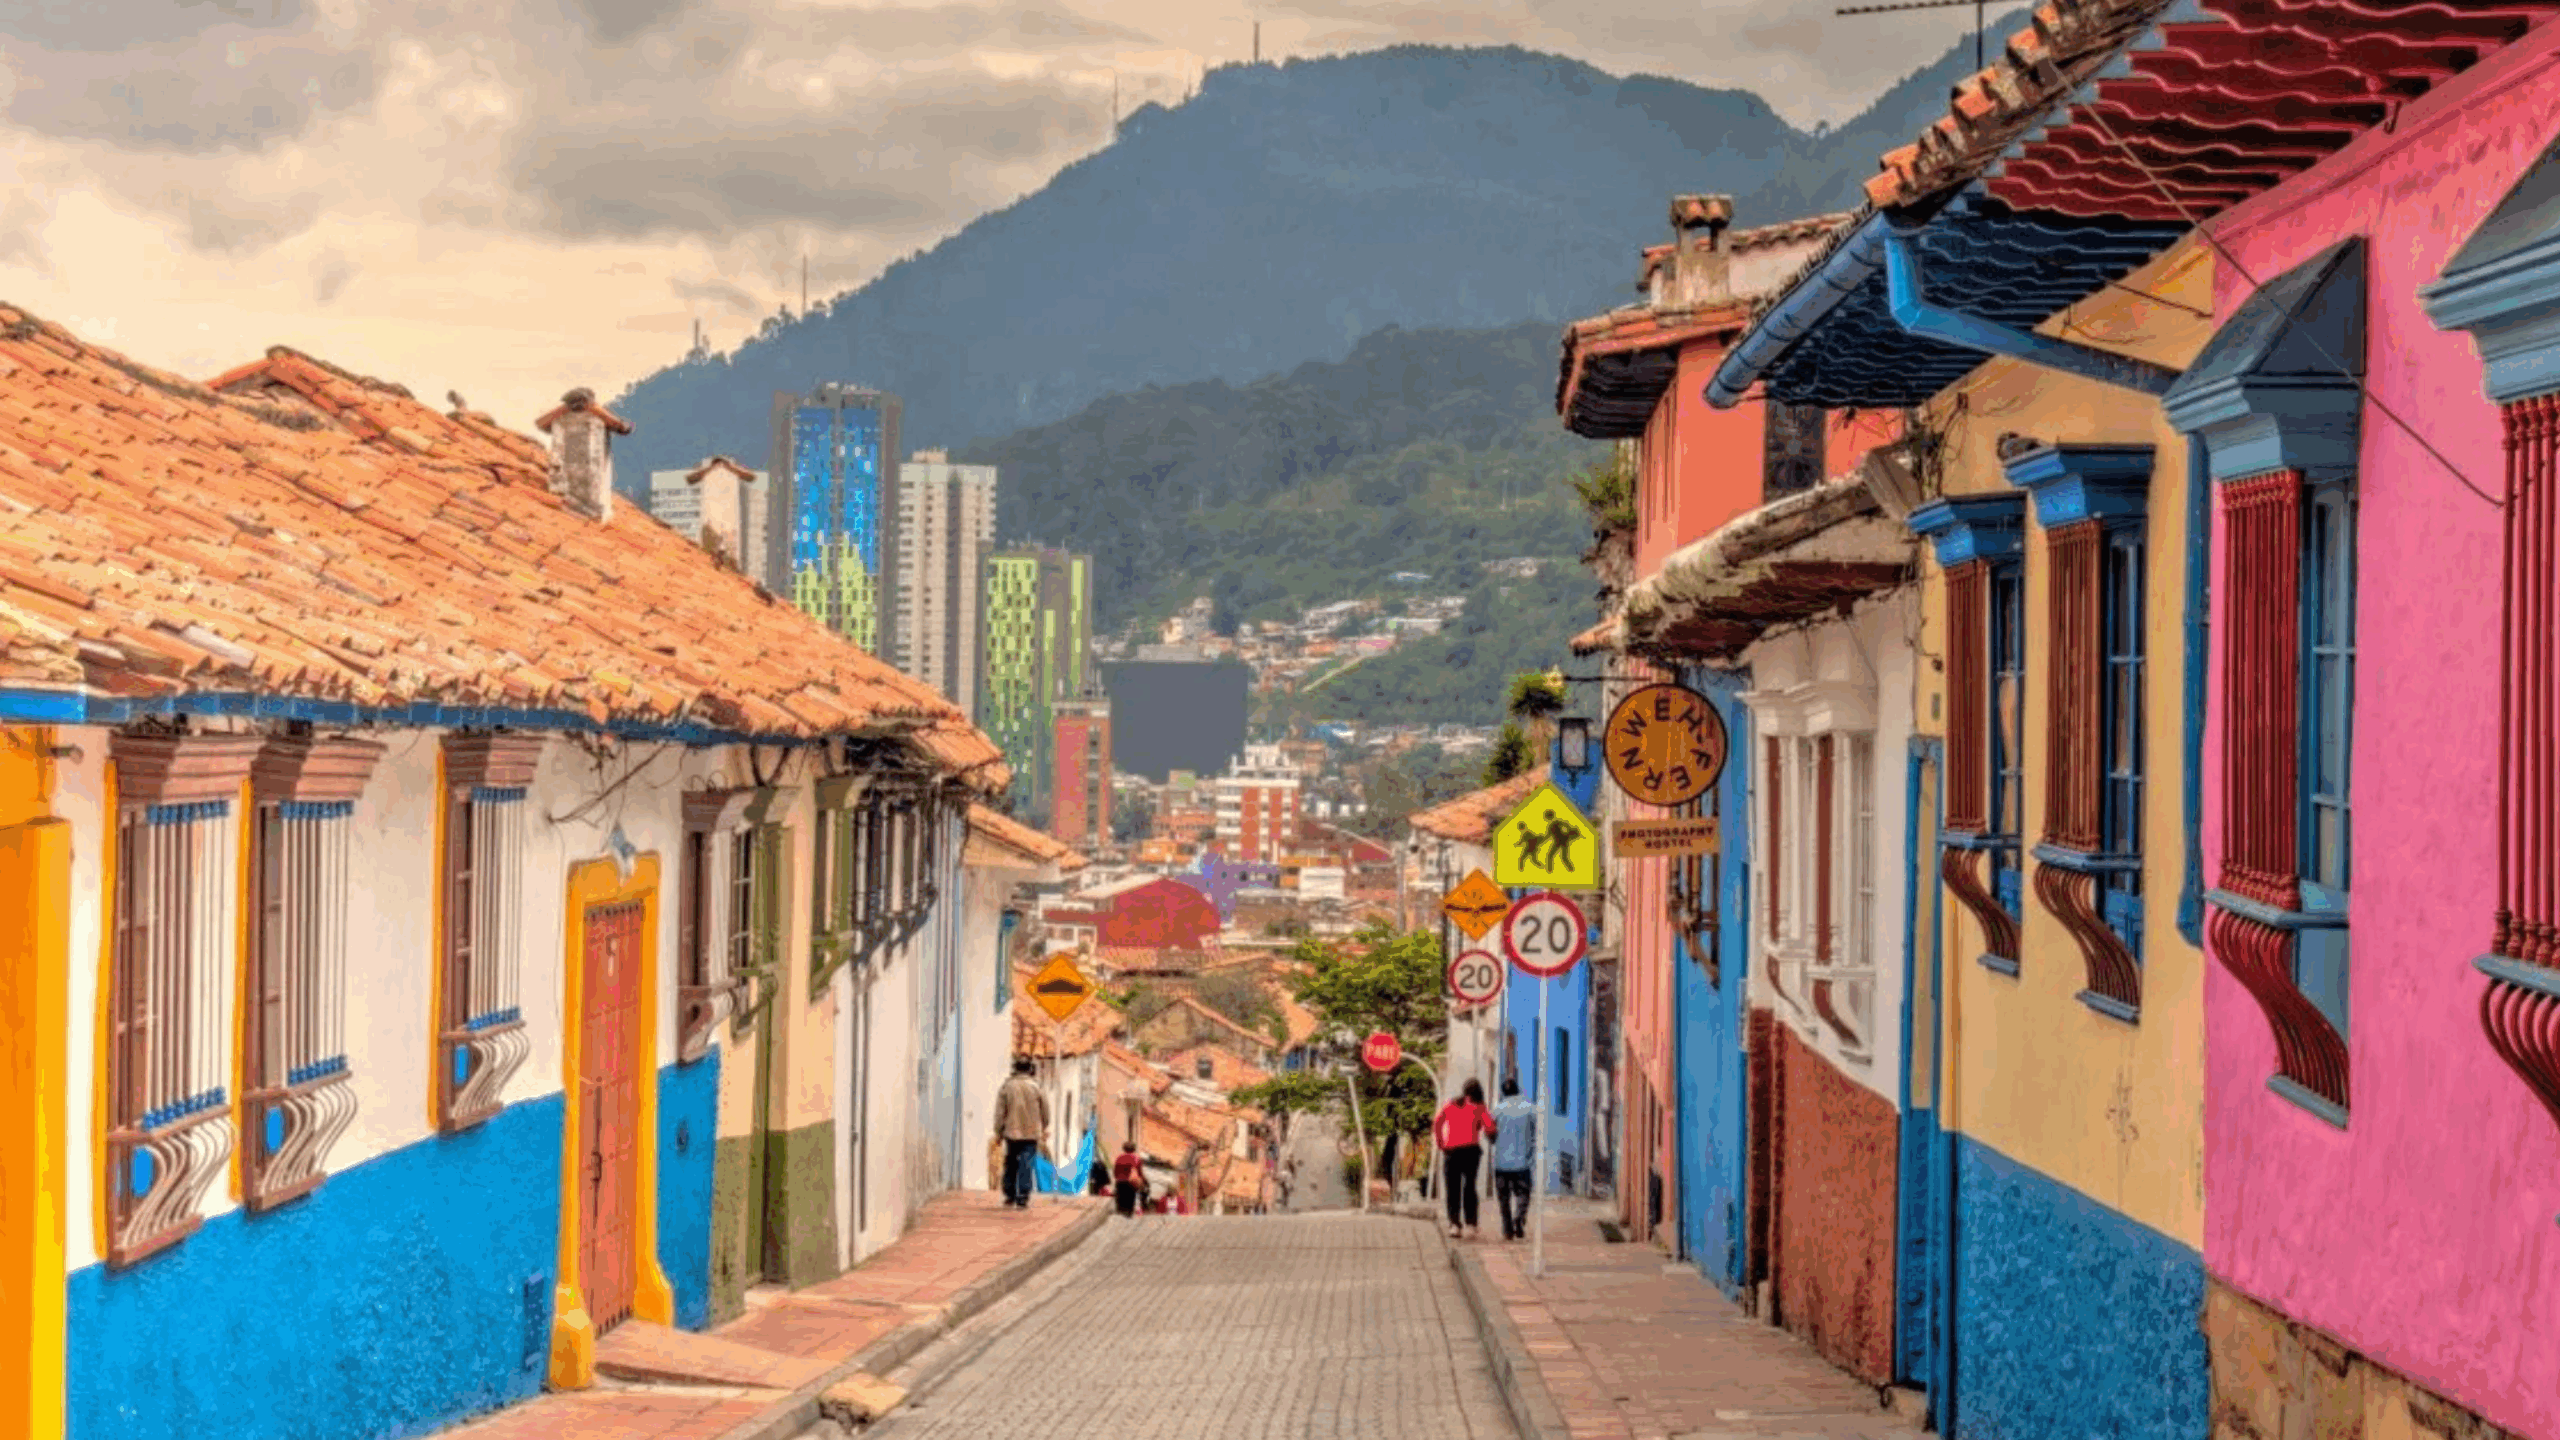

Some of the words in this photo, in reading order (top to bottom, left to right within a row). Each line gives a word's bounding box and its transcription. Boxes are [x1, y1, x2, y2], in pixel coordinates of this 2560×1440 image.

[1620, 826, 1714, 839] PHOTOGRAPHY
[1644, 838, 1693, 849] HOSTEL
[1519, 913, 1571, 955] 20
[1459, 963, 1494, 990] 20
